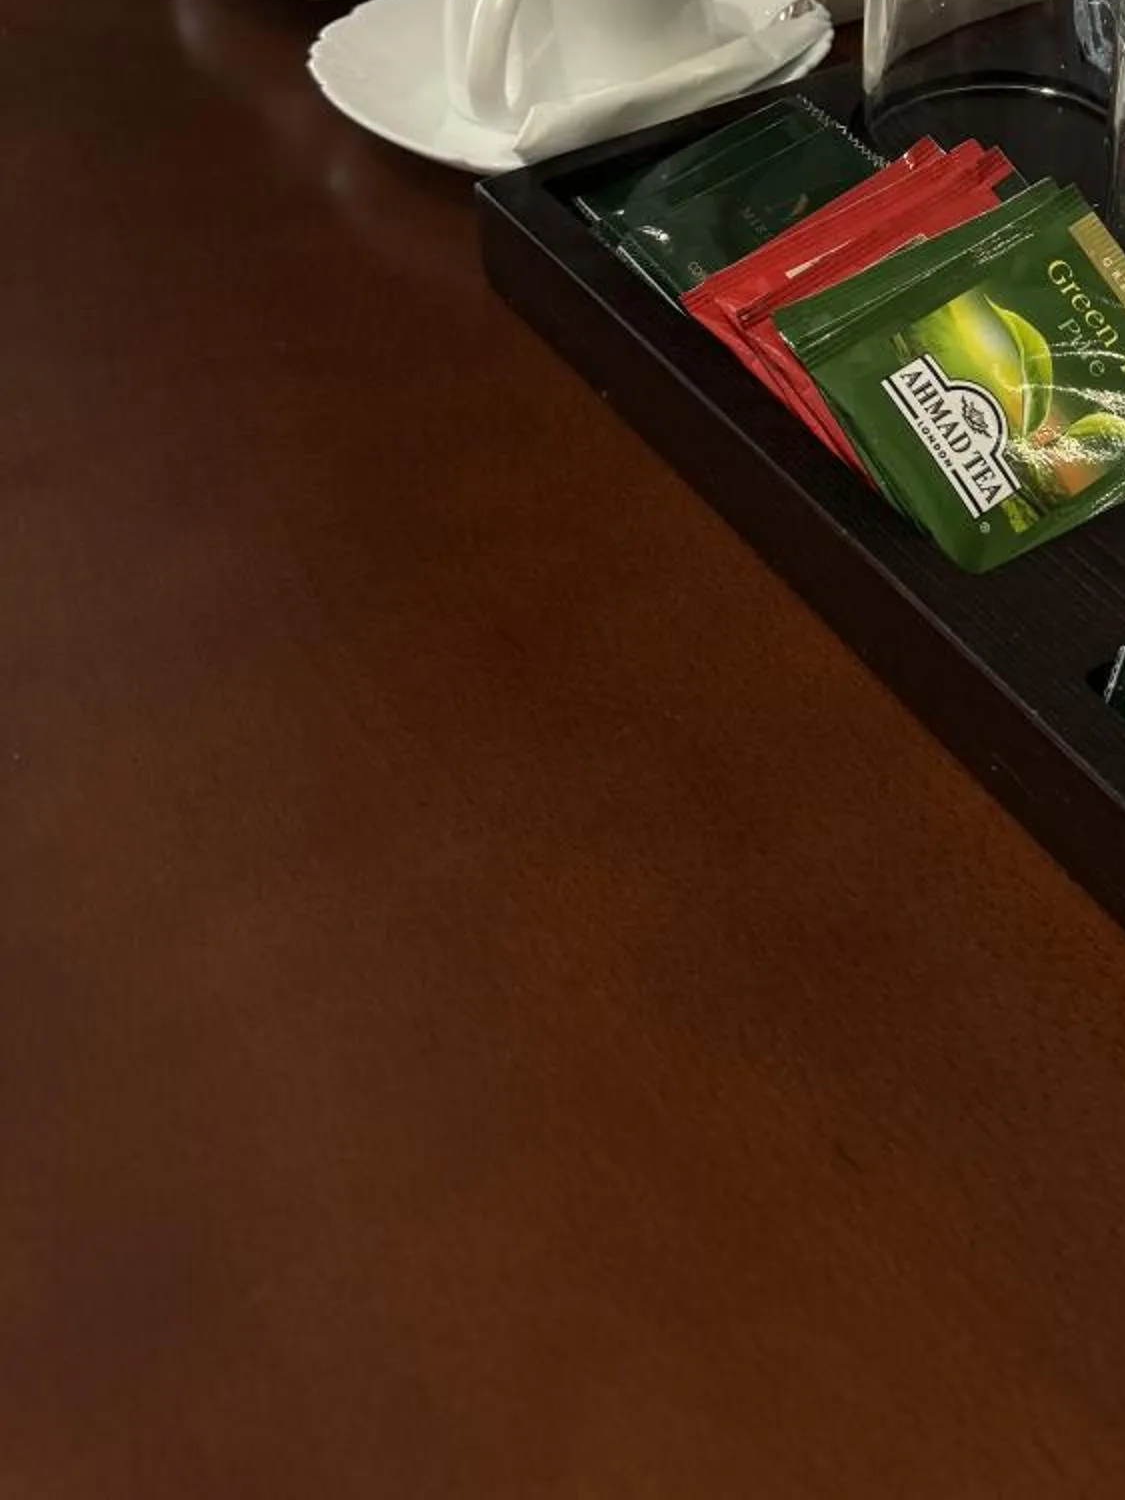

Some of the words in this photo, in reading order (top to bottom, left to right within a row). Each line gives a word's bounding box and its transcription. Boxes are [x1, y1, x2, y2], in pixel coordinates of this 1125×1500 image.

[1048, 260, 1119, 348] Green
[900, 370, 972, 453] AHMAD
[962, 449, 1003, 504] TEA
[917, 420, 953, 469] LONDON
